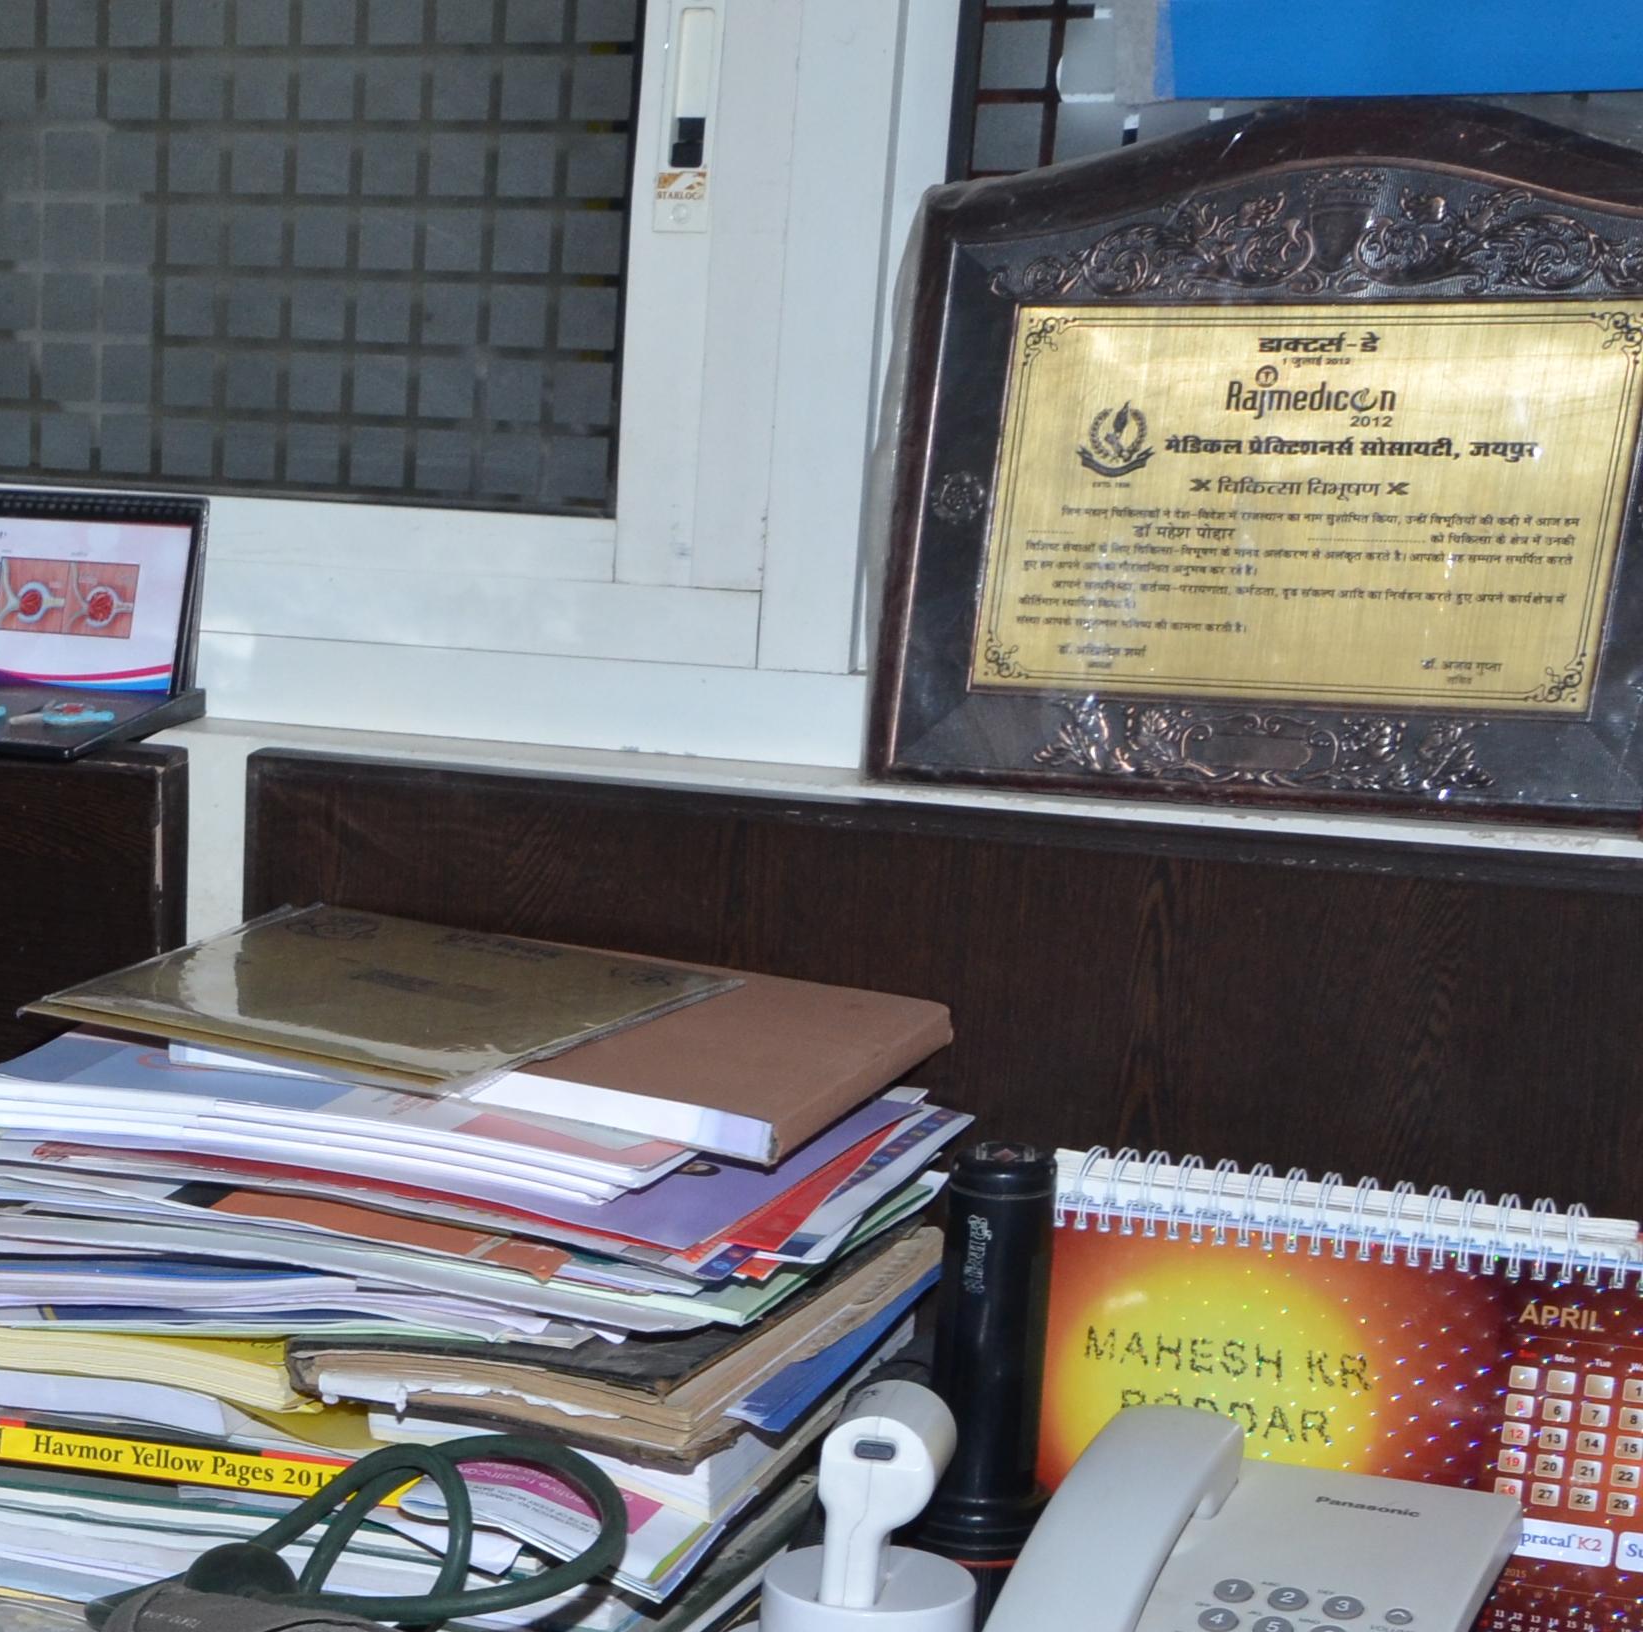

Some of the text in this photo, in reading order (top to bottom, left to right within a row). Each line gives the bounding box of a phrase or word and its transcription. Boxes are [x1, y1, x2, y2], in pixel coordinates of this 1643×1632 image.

[1349, 415, 1393, 428] 2012
[1165, 434, 1242, 456] मेडिकल
[1360, 436, 1461, 460] सोसायटी,
[1469, 440, 1539, 463] जयपुर
[1217, 477, 1381, 502] चिकित्सा विभूषण
[1154, 527, 1190, 540] महेश
[1518, 1303, 1606, 1334] APRIL
[1083, 1324, 1373, 1391] MAHESH KR
[1554, 1353, 1576, 1366] Mon
[1593, 1357, 1613, 1369] Tue
[1552, 1405, 1639, 1426] 6 7 8
[1509, 1428, 1638, 1454] 12 13 14 15
[33, 1434, 275, 1487] Havmor Yellow Pages
[1505, 1456, 1634, 1483] 19 20 21 22
[1315, 1495, 1421, 1519] Panasonic
[1537, 1488, 1630, 1511] 27 28 29
[1576, 1536, 1603, 1553] K2
[1503, 1567, 1527, 1580] 2015
[1228, 1583, 1240, 1595] 1
[1281, 1591, 1296, 1604] 2
[1335, 1600, 1350, 1612] 3
[1209, 1612, 1225, 1625] 4
[1530, 1614, 1541, 1624] 13
